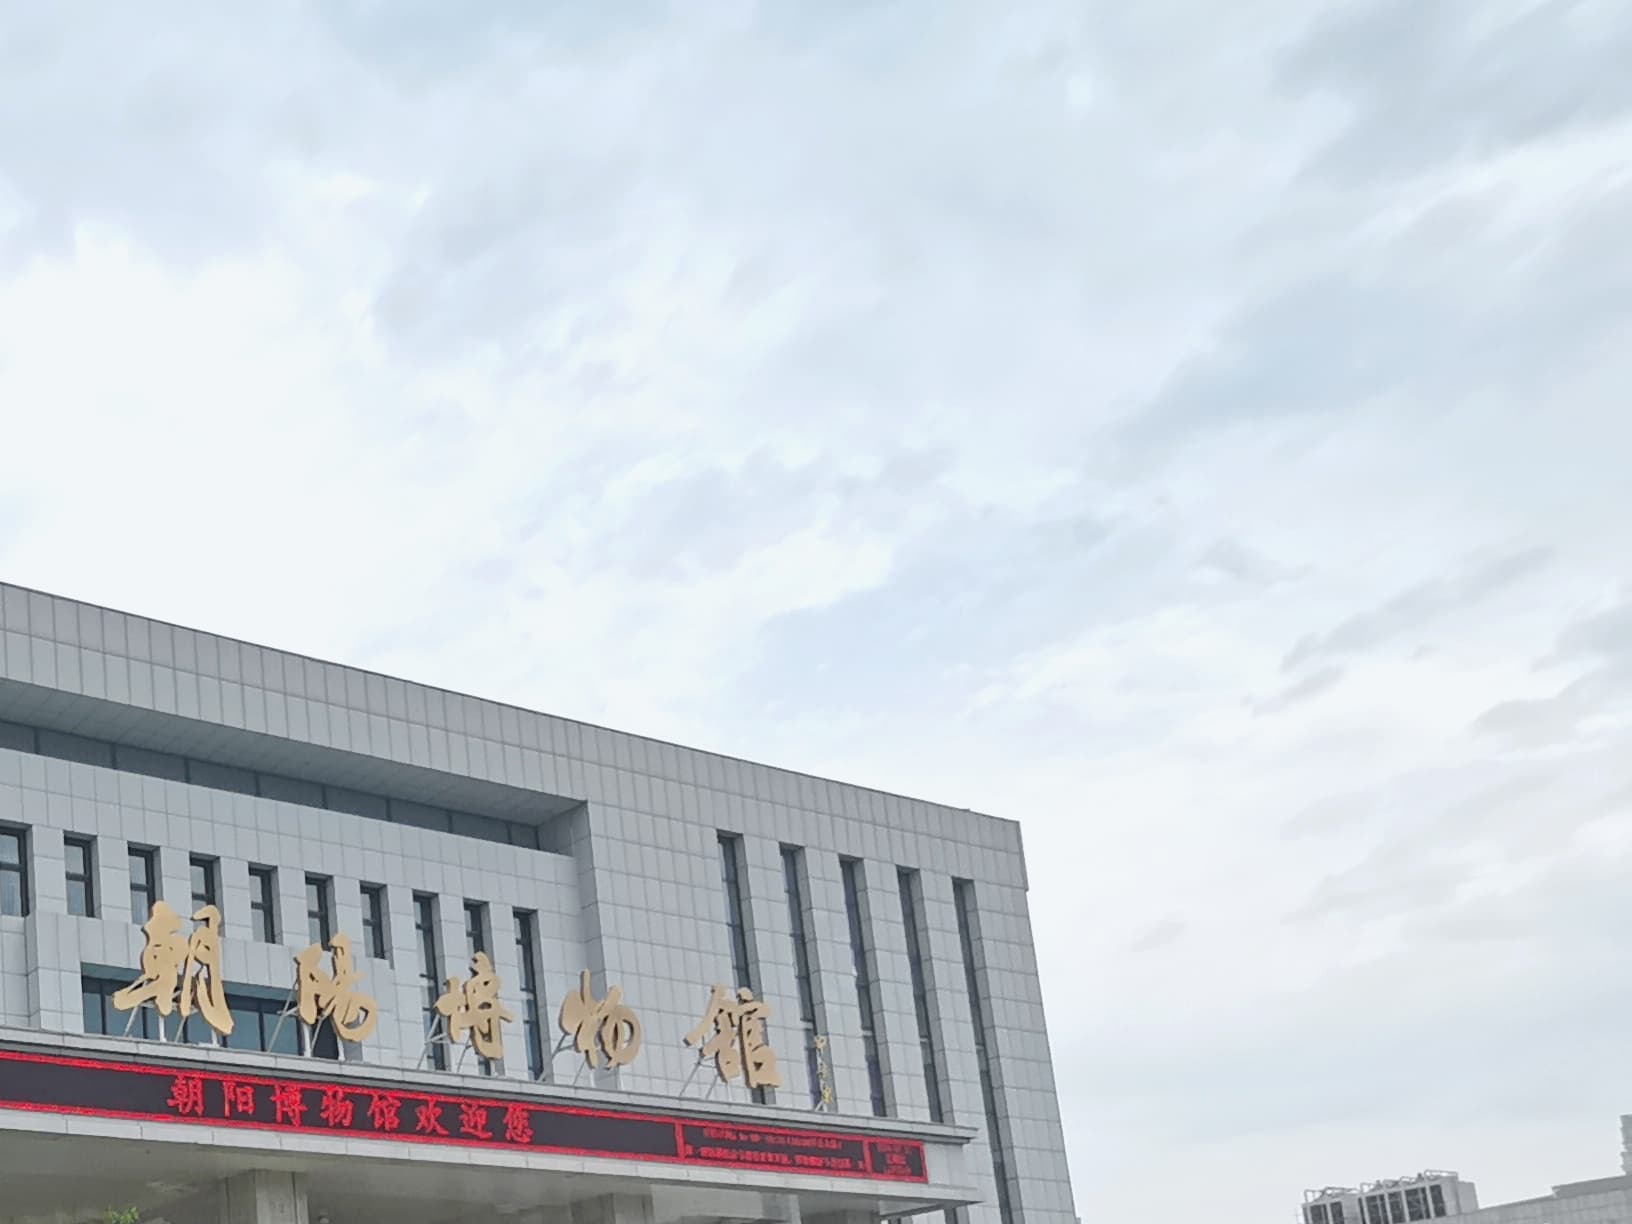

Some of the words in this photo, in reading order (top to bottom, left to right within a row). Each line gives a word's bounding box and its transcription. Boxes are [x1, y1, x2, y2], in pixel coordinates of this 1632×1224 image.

[168, 1073, 533, 1143] 朝阳博物馆欢迎您
